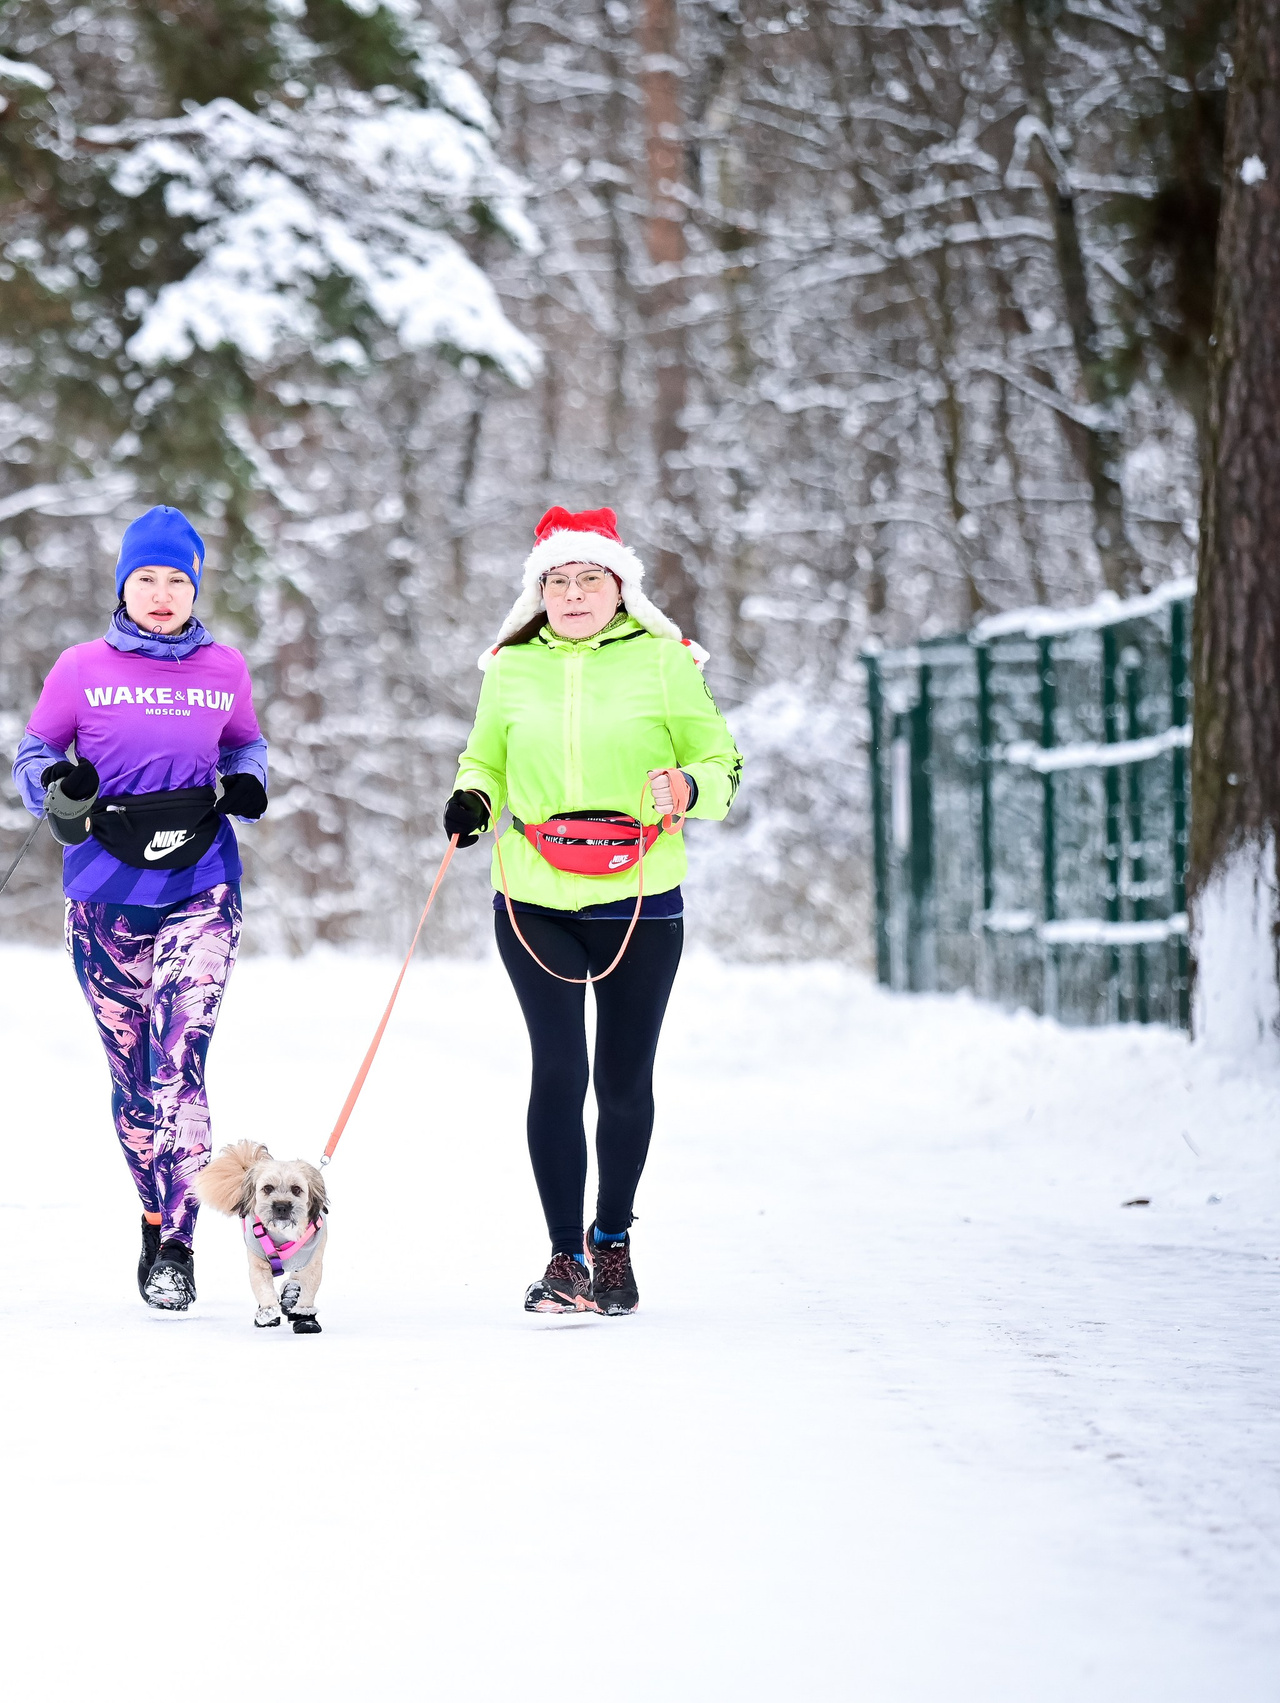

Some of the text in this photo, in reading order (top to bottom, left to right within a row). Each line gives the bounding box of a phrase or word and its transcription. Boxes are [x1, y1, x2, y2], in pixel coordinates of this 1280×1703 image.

[145, 708, 191, 717] MOSCOW
[151, 829, 187, 848] NIKE
[545, 835, 565, 845] NIKE
